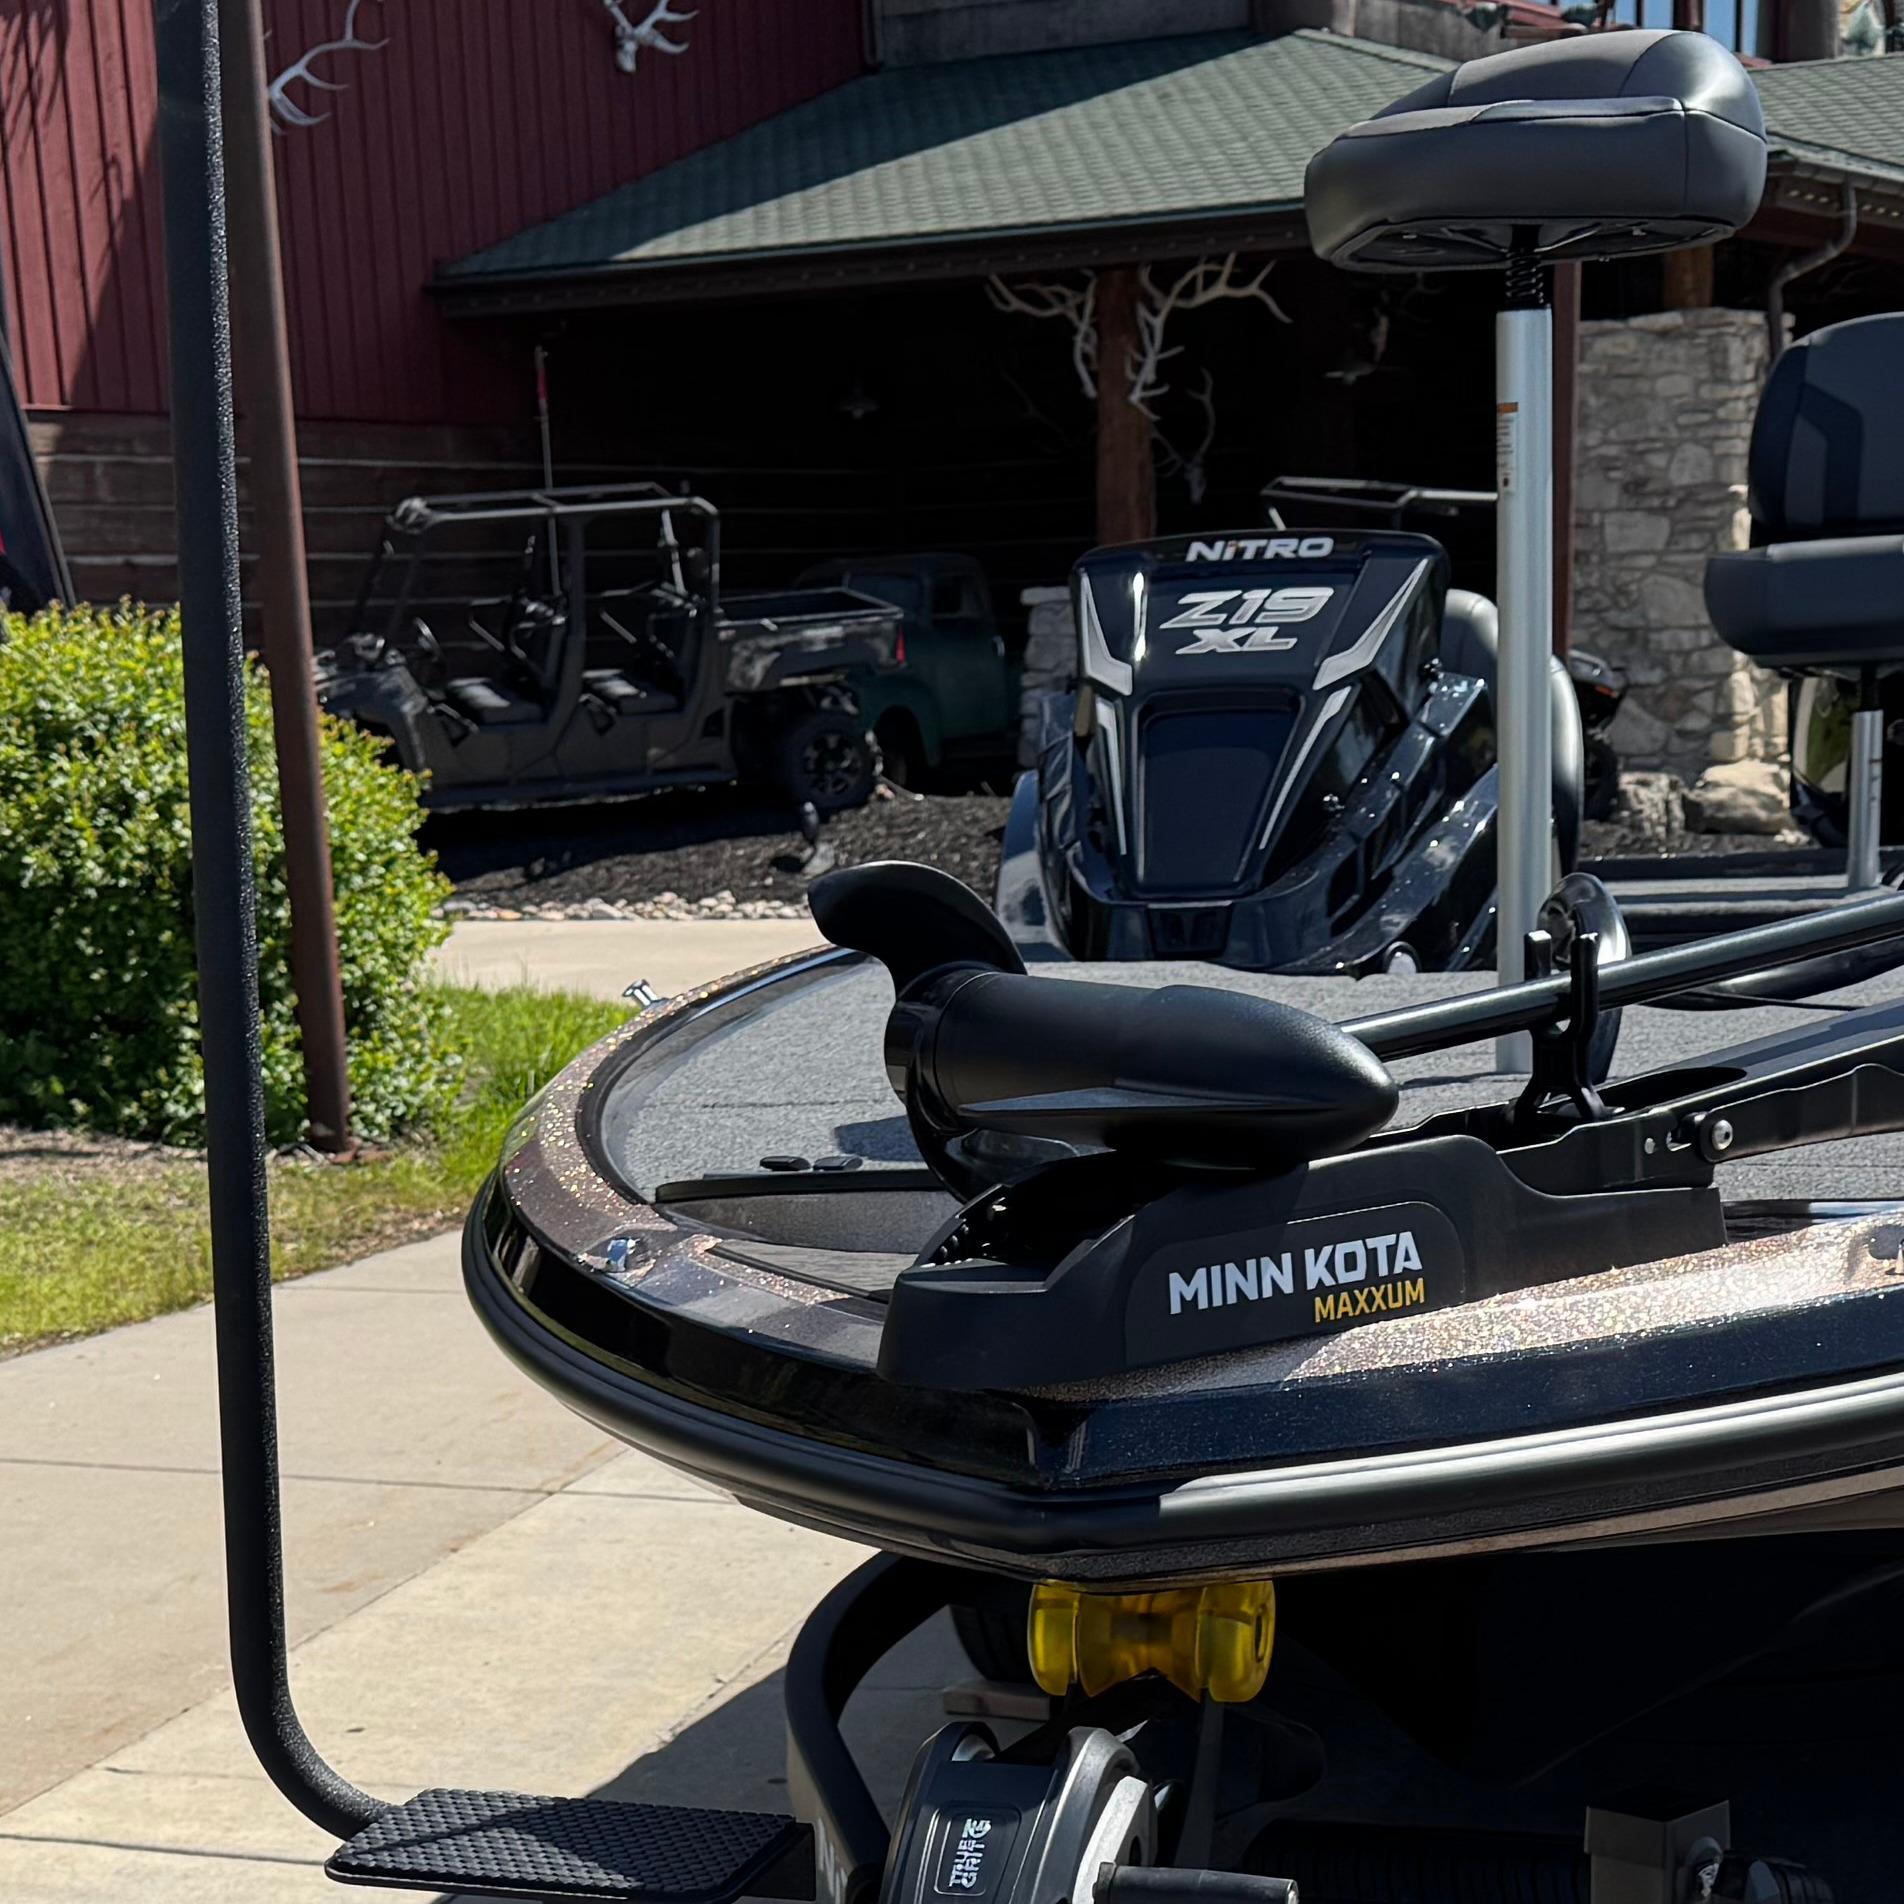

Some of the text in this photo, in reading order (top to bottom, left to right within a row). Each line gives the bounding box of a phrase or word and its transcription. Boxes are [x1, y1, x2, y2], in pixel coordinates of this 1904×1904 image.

[1159, 587, 1335, 629] Z19
[1175, 626, 1298, 654] XL
[1169, 1231, 1423, 1315] MINN KOTA
[1314, 1278, 1425, 1323] MAXXUM
[961, 1839, 986, 1888] GRIT
